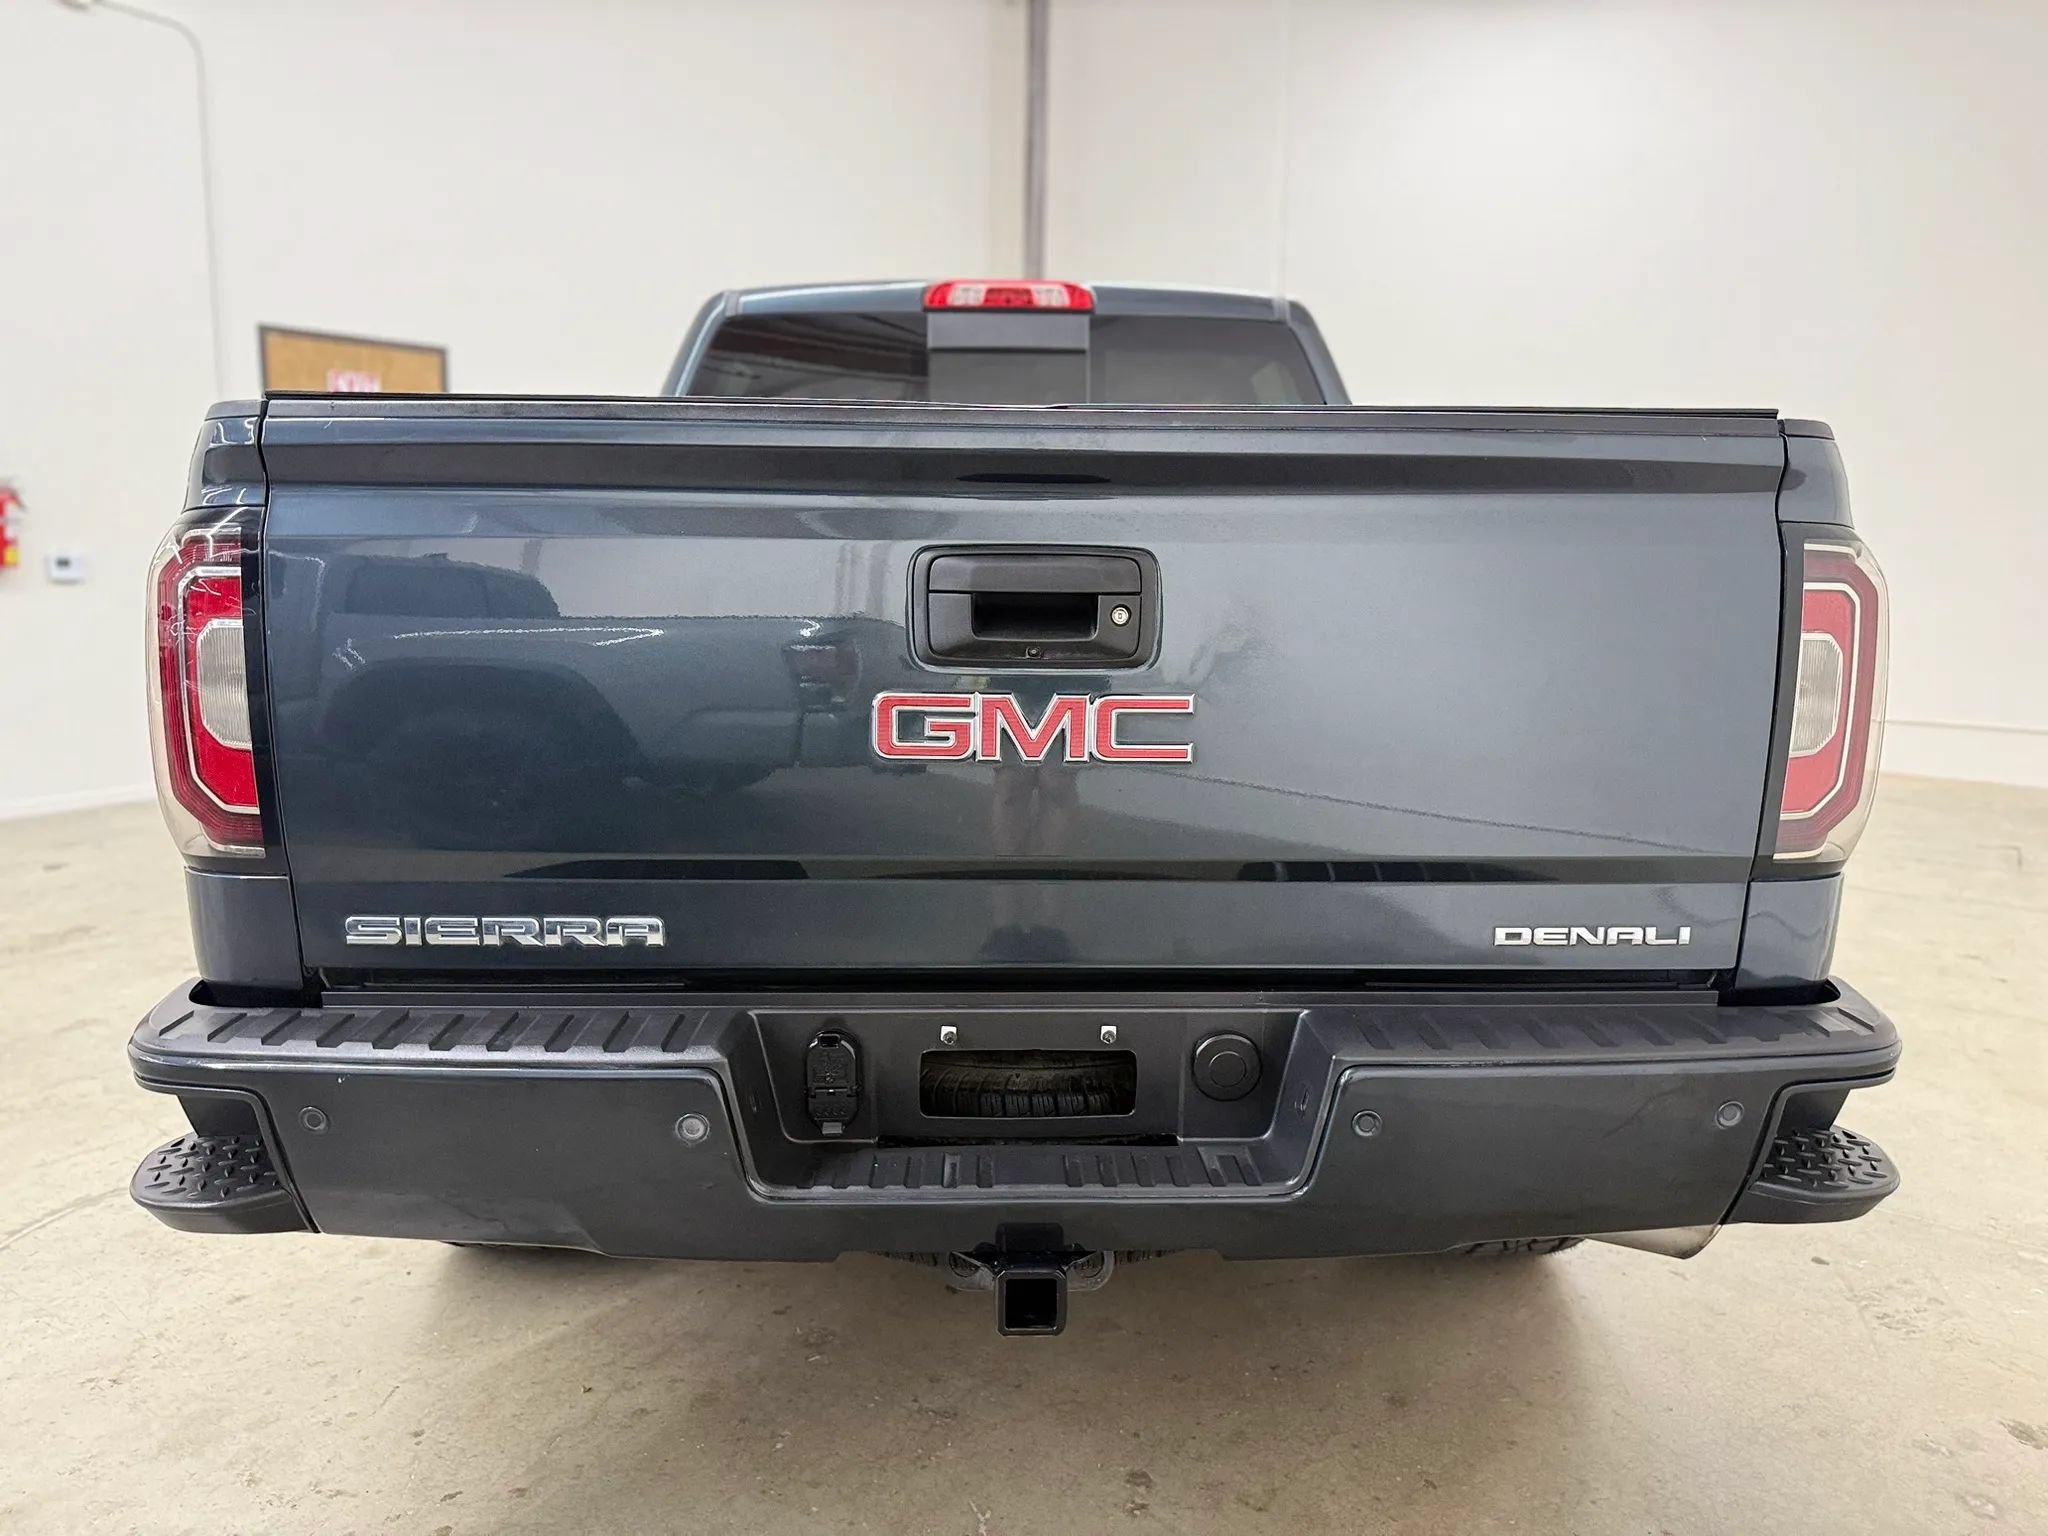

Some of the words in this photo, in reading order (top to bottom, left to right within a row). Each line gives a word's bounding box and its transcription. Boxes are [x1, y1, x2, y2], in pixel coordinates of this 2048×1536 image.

[871, 692, 1195, 762] GMC
[345, 915, 665, 947] SIERRA
[1494, 926, 1691, 946] DENALI
